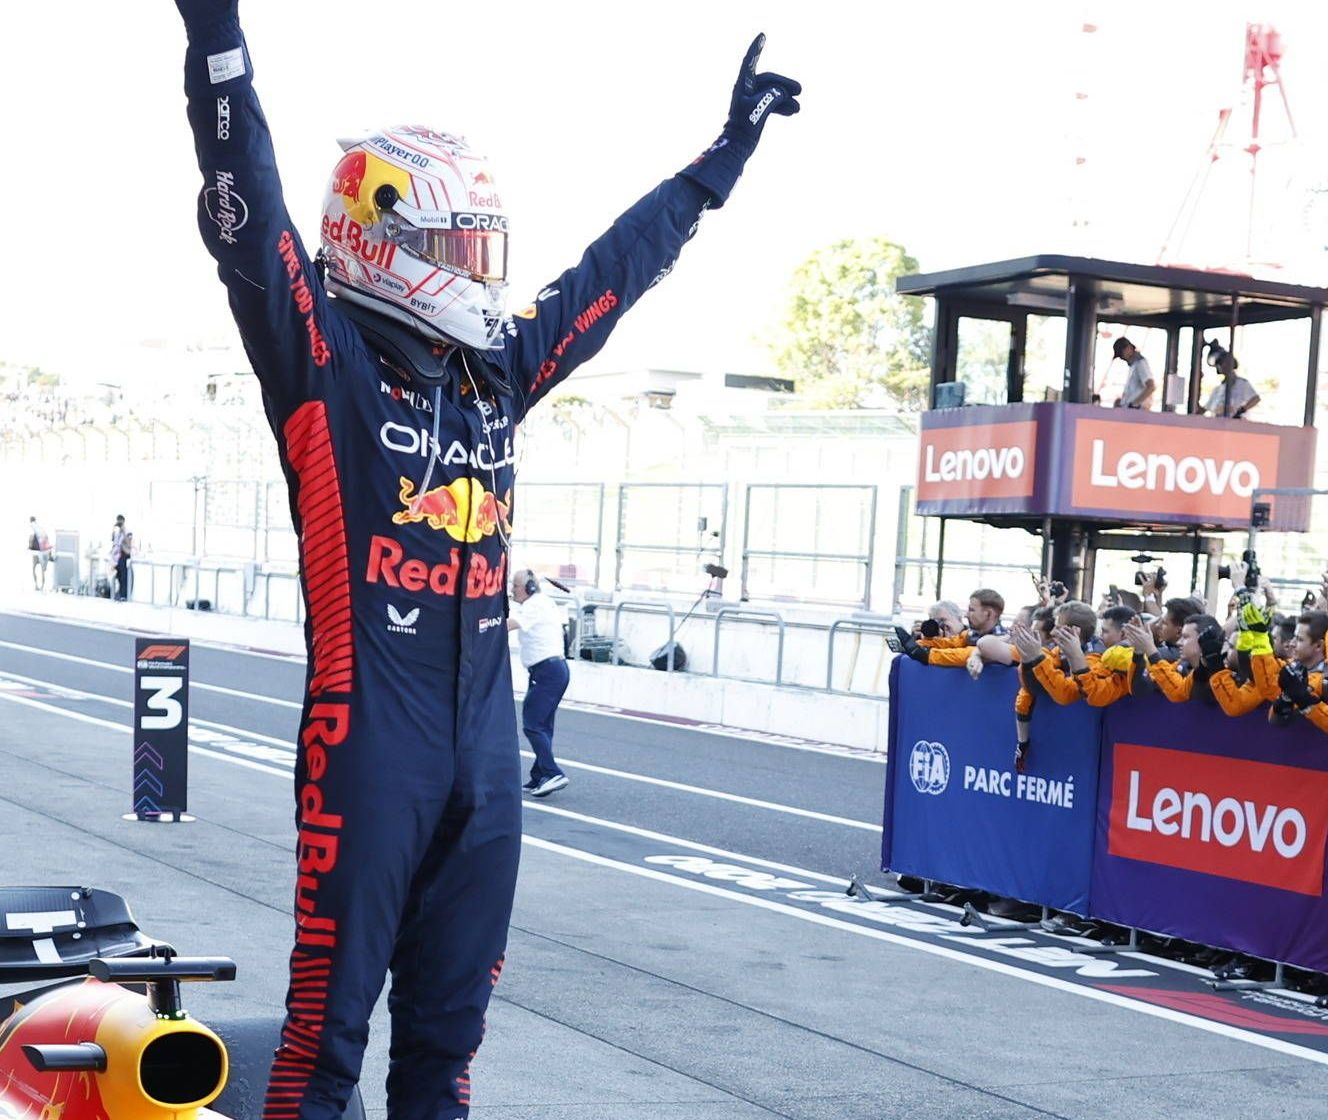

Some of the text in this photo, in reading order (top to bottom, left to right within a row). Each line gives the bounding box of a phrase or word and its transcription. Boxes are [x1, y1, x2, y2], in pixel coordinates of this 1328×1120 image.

[322, 214, 346, 243] ed
[347, 223, 397, 271] Bull
[574, 289, 618, 334] WINGS
[925, 444, 1025, 482] Lenovo
[1090, 439, 1260, 498] Lenovo
[366, 534, 461, 597] Red
[140, 676, 183, 730] 3
[963, 765, 1074, 810] PARC FERMÉ
[1126, 770, 1307, 859] Lenovo
[295, 703, 350, 947] Red Bull
